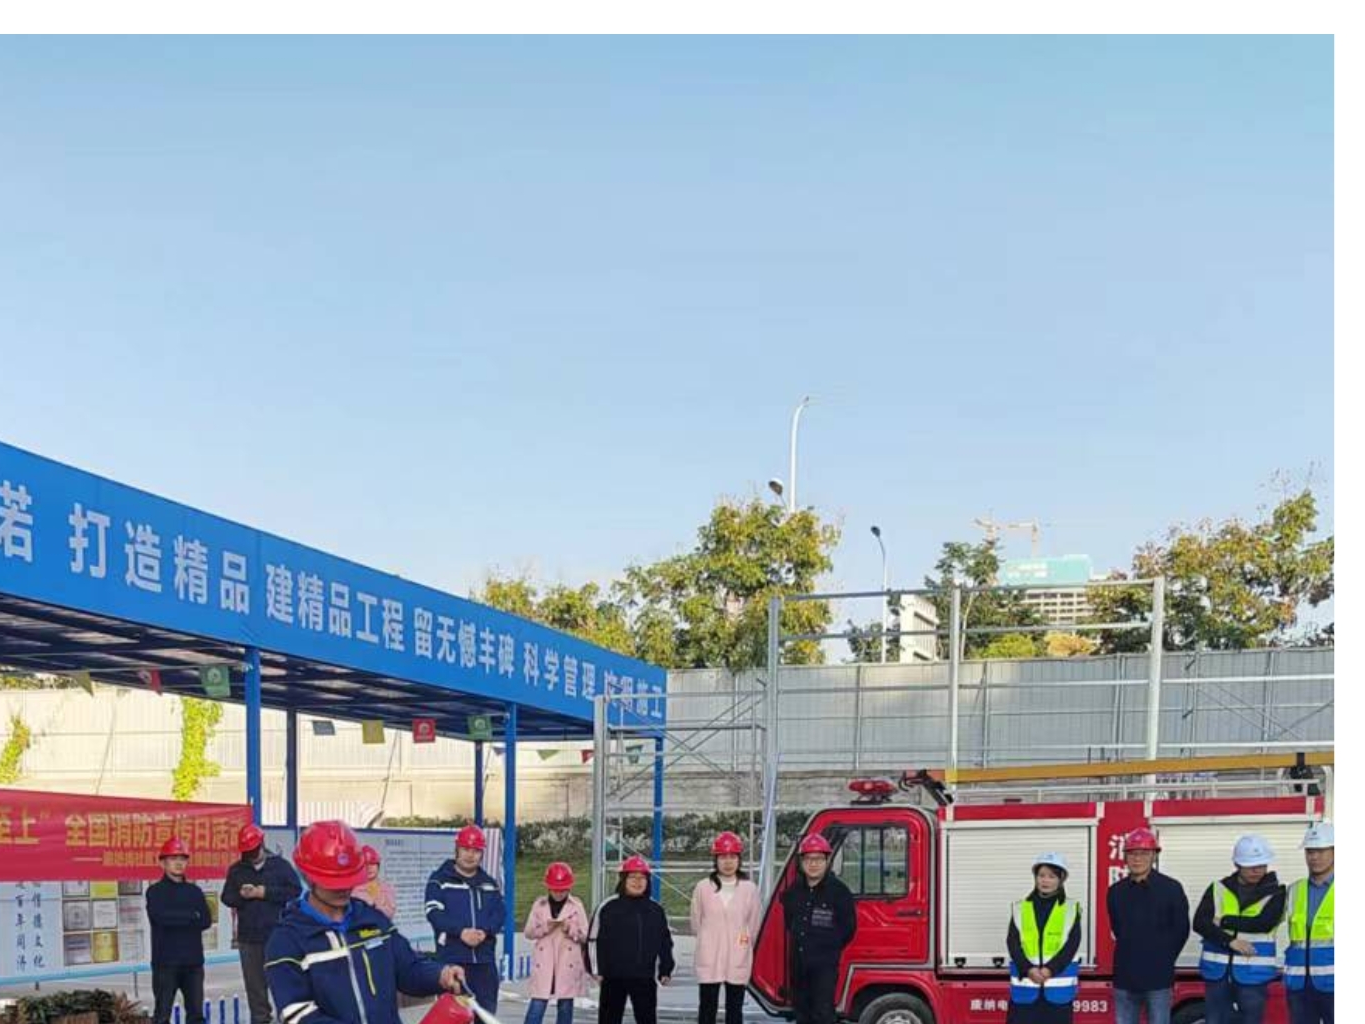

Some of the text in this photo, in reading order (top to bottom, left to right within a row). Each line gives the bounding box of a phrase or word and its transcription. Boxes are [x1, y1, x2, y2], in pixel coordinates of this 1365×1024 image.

[69, 502, 250, 616] 打造精品
[266, 564, 405, 652] 建精品工程
[412, 607, 515, 679] 留无憾丰碑
[523, 642, 595, 701] 科学管理
[1072, 1000, 1108, 1012] 9983
